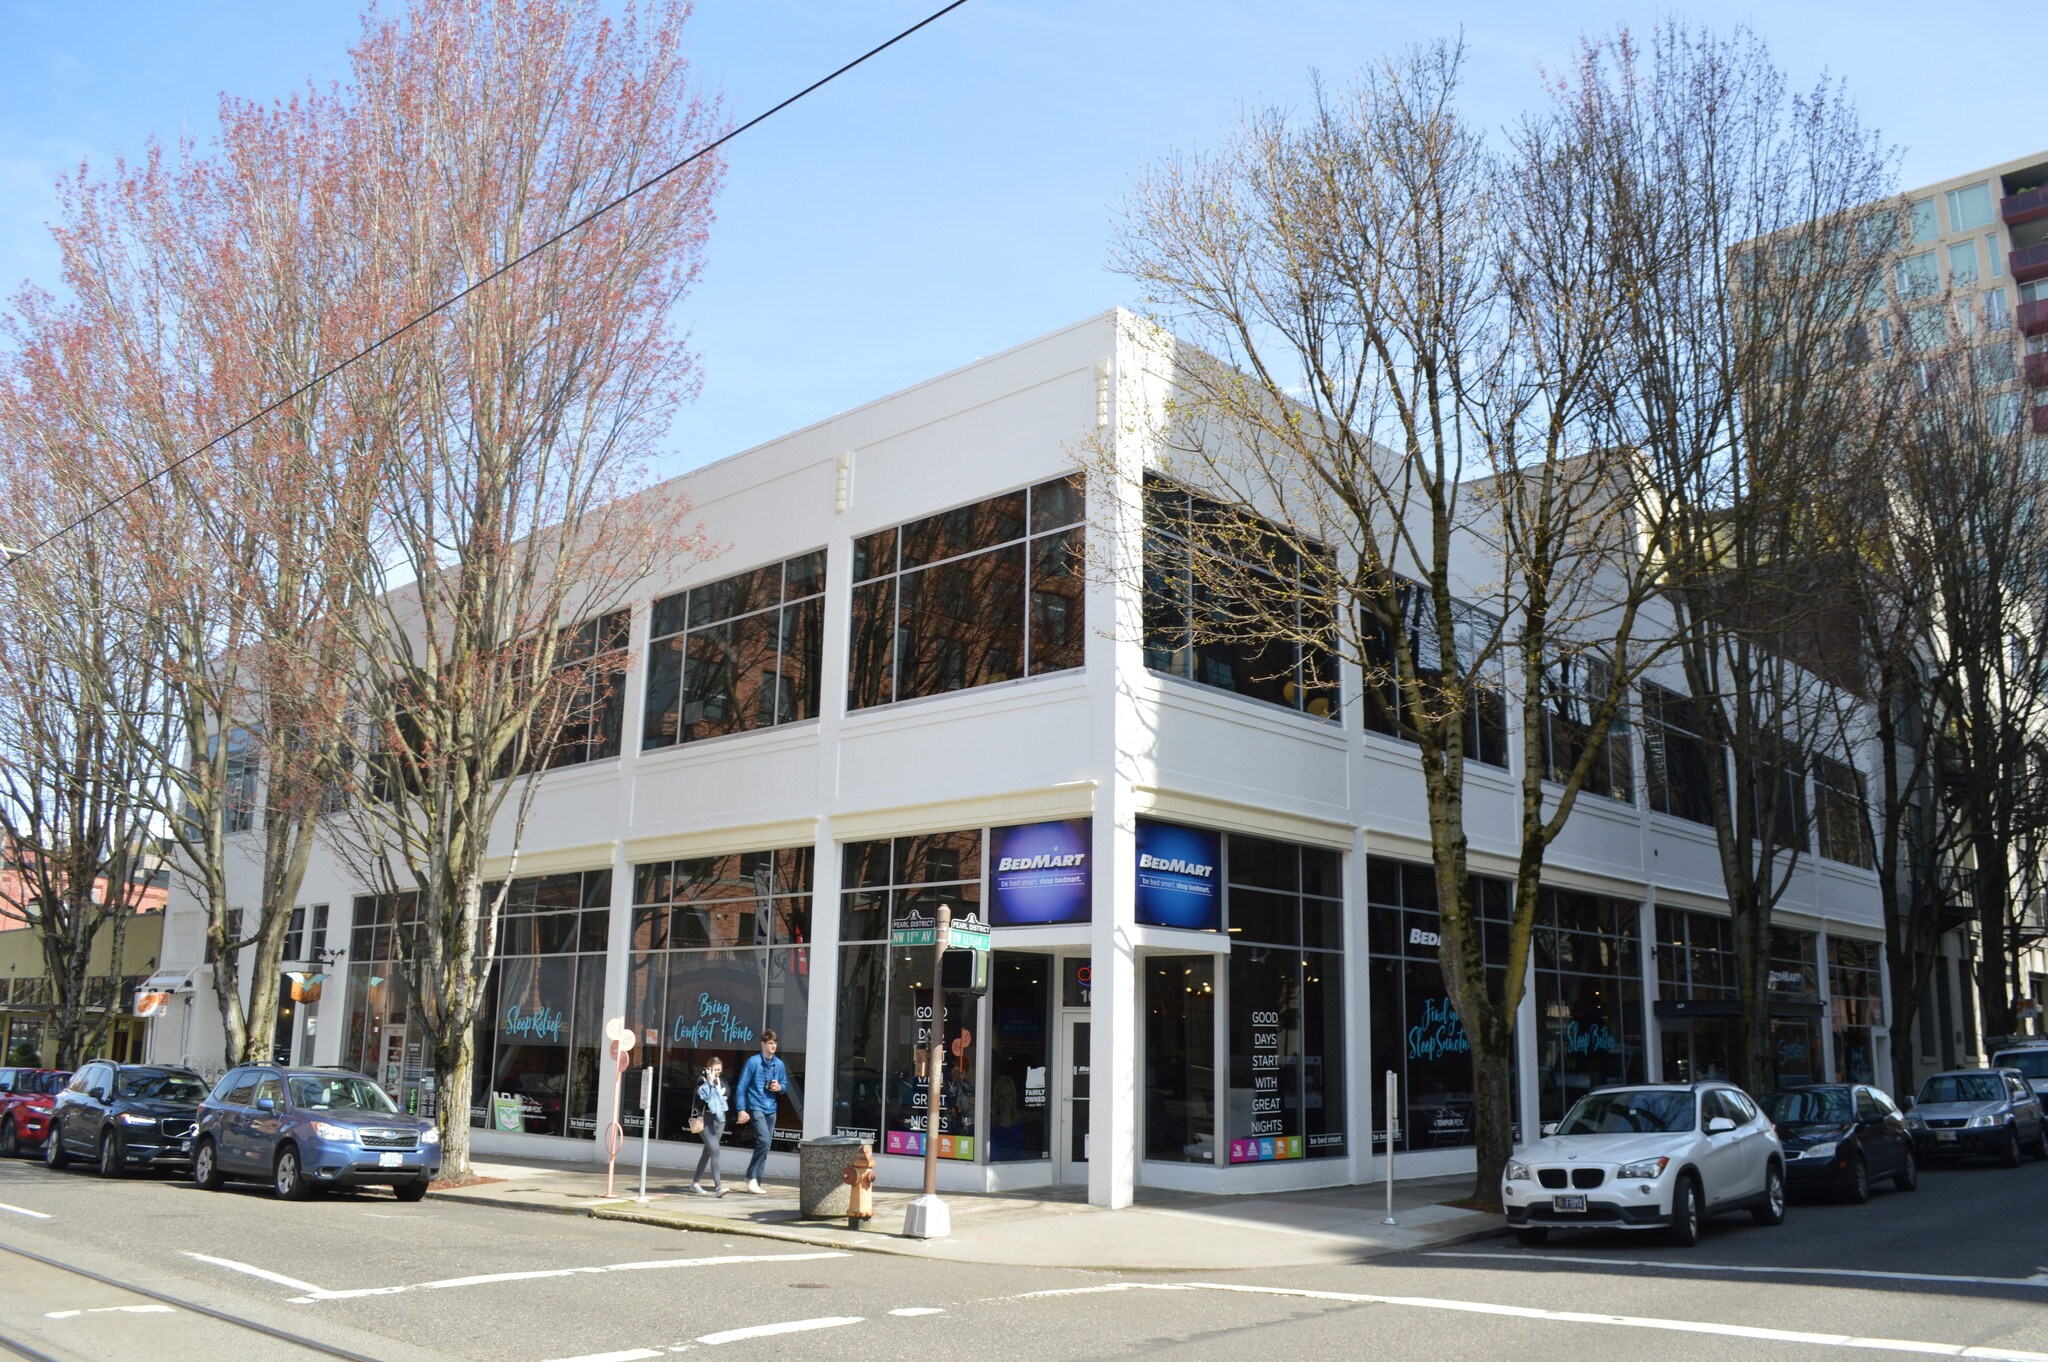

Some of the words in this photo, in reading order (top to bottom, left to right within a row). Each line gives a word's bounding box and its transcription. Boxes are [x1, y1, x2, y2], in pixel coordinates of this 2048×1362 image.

[998, 853, 1085, 871] BEDMART
[1139, 853, 1213, 877] BEDMART
[1009, 879, 1021, 887] bed
[1039, 878, 1054, 886] shop
[1176, 882, 1189, 891] shop
[952, 921, 969, 930] PEARL
[968, 923, 990, 933] DISTRICT
[893, 932, 905, 944] NW
[921, 930, 932, 942] AV
[952, 931, 962, 943] NW
[1409, 927, 1441, 947] BED
[698, 992, 730, 1027] Bring
[1421, 996, 1450, 1032] Find
[1252, 1011, 1279, 1024] GOOD
[505, 1005, 532, 1039] Sleep
[532, 1006, 562, 1043] Relief
[674, 1015, 719, 1048] Comfort
[721, 1015, 754, 1044] Home
[1254, 1033, 1277, 1045] DAYS
[1408, 1025, 1436, 1061] Sleep
[1435, 1025, 1472, 1058] Sanctu
[1567, 1020, 1590, 1056] Sleep
[1252, 1055, 1279, 1067] START
[1255, 1076, 1278, 1089] WITH
[1025, 1088, 1046, 1096] FAMILY
[1024, 1095, 1046, 1103] OWNED
[1252, 1098, 1281, 1110] GREAT
[630, 1117, 640, 1125] bed
[1251, 1119, 1283, 1133] NIGHTS
[773, 1130, 784, 1138] bed
[784, 1132, 801, 1140] smart
[837, 1128, 846, 1136] be
[846, 1129, 858, 1138] bed
[858, 1130, 876, 1139] smart
[1372, 1133, 1379, 1141] be
[1310, 1137, 1317, 1145] be
[1317, 1136, 1327, 1144] bed
[1328, 1136, 1342, 1144] smart
